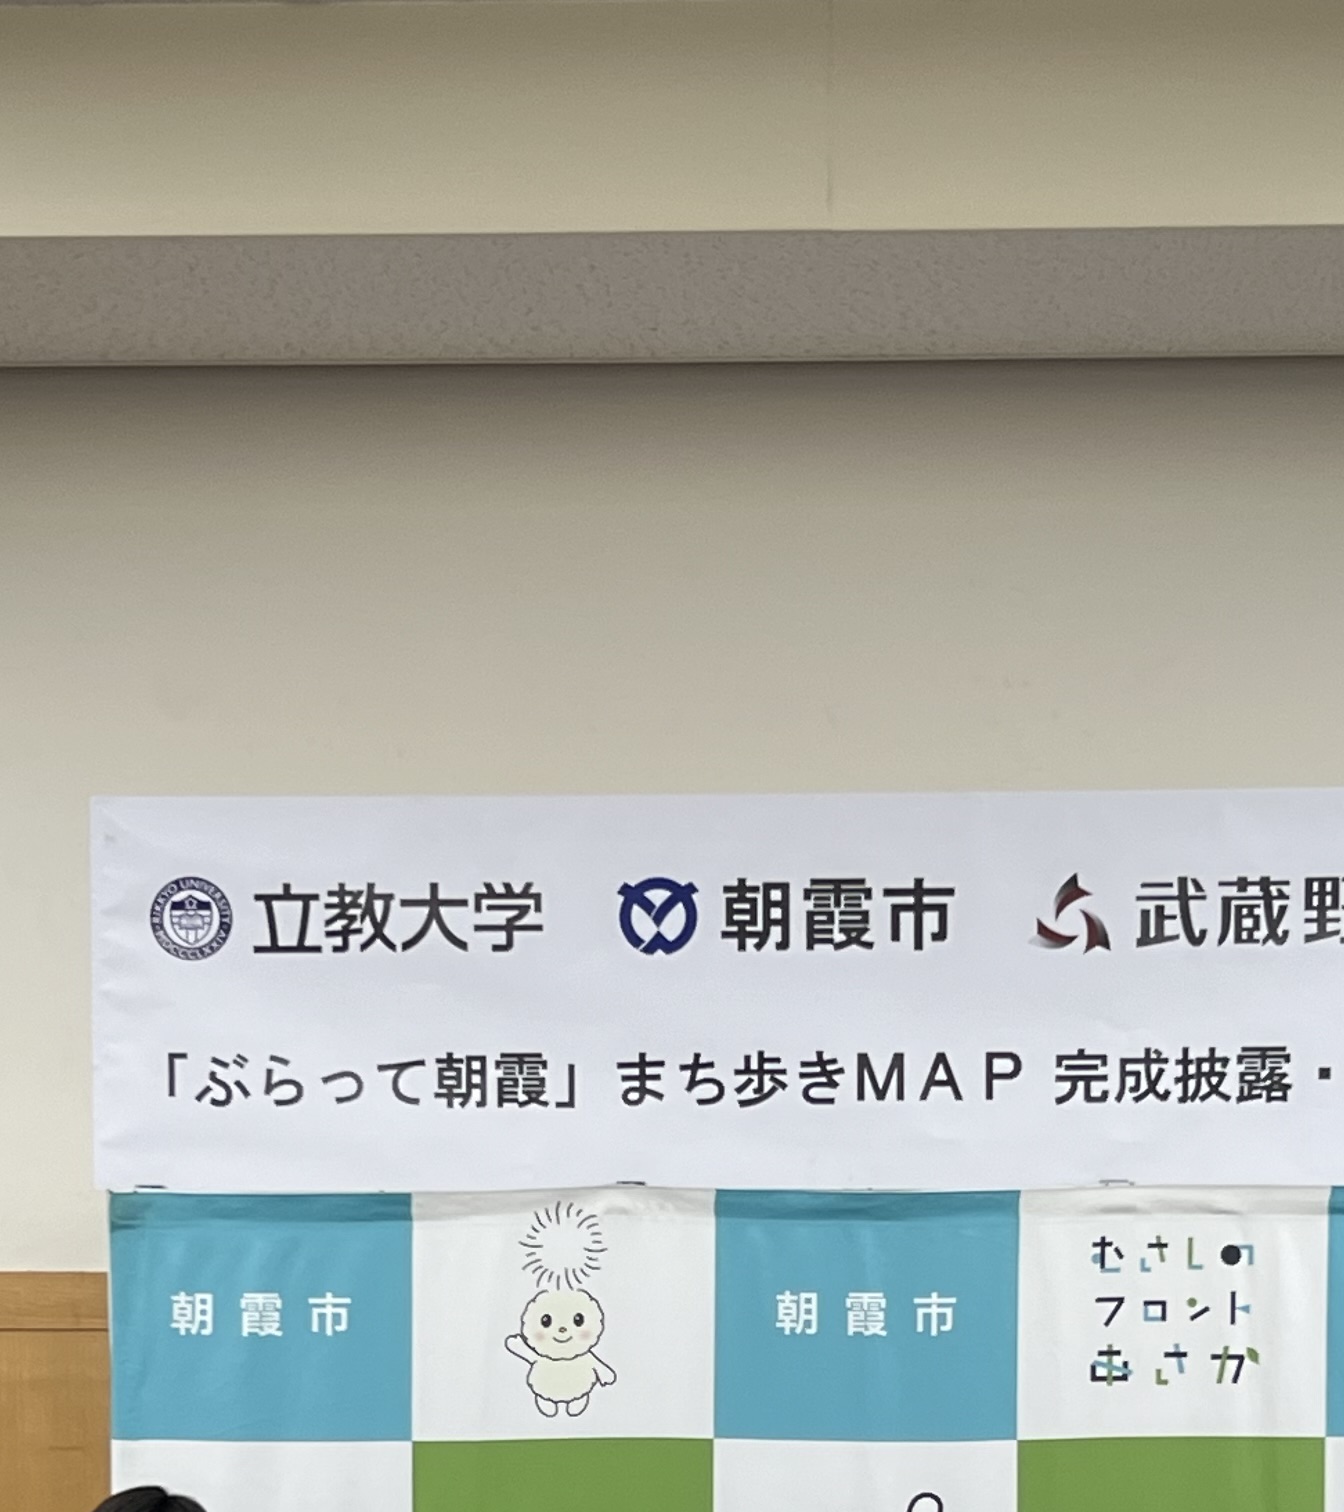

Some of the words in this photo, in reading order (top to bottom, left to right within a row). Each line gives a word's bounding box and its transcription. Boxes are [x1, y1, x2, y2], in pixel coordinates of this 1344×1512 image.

[253, 882, 544, 954] 立教大学
[721, 877, 955, 952] 朝霞市
[165, 1051, 576, 1109] 「ぶらって朝霞」
[617, 1050, 1023, 1107] まち歩きMAP
[1091, 1235, 1254, 1273] むさしの
[170, 1291, 352, 1337] 朝霞市
[775, 1289, 957, 1337] 朝霞市
[1094, 1290, 1251, 1327] フロント
[1090, 1343, 1260, 1386] あさか
